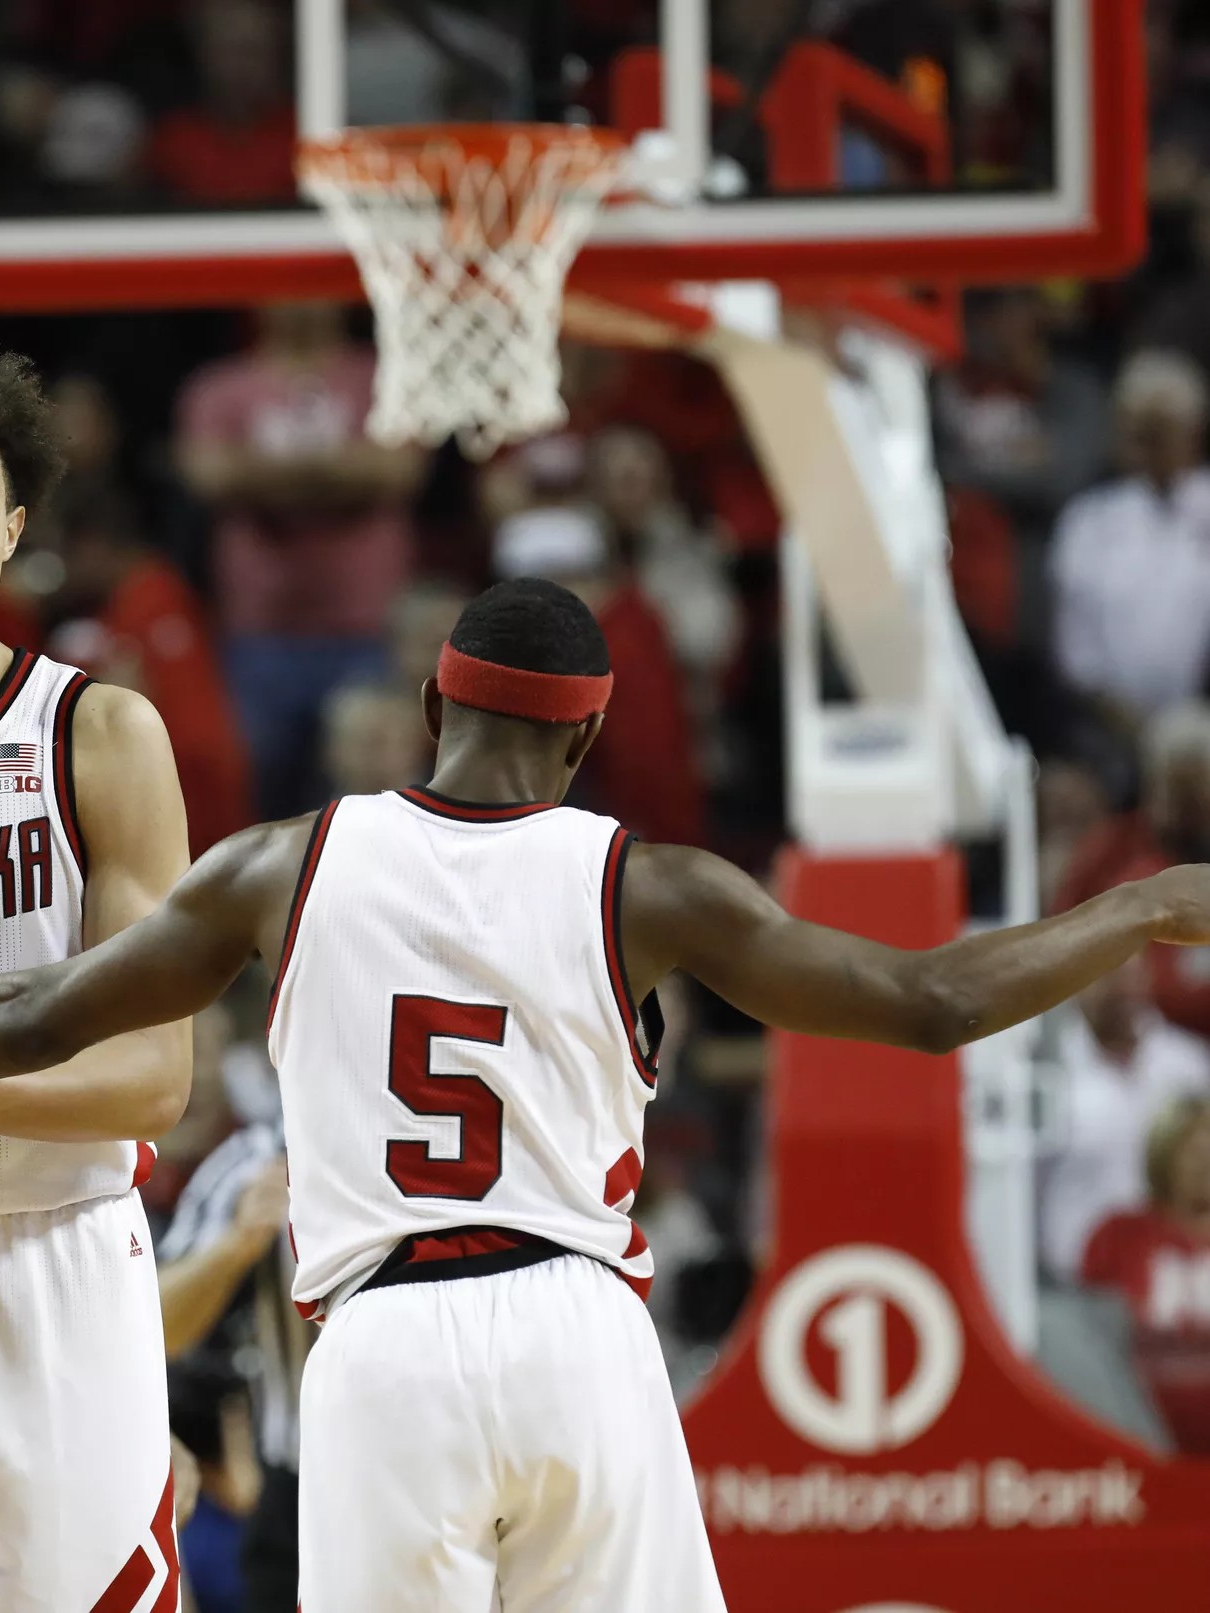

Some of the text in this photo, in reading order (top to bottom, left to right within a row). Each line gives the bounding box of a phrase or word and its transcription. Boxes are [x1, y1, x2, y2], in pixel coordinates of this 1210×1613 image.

[385, 993, 508, 1202] 5
[711, 1463, 980, 1533] National
[985, 1458, 1147, 1530] Bank
